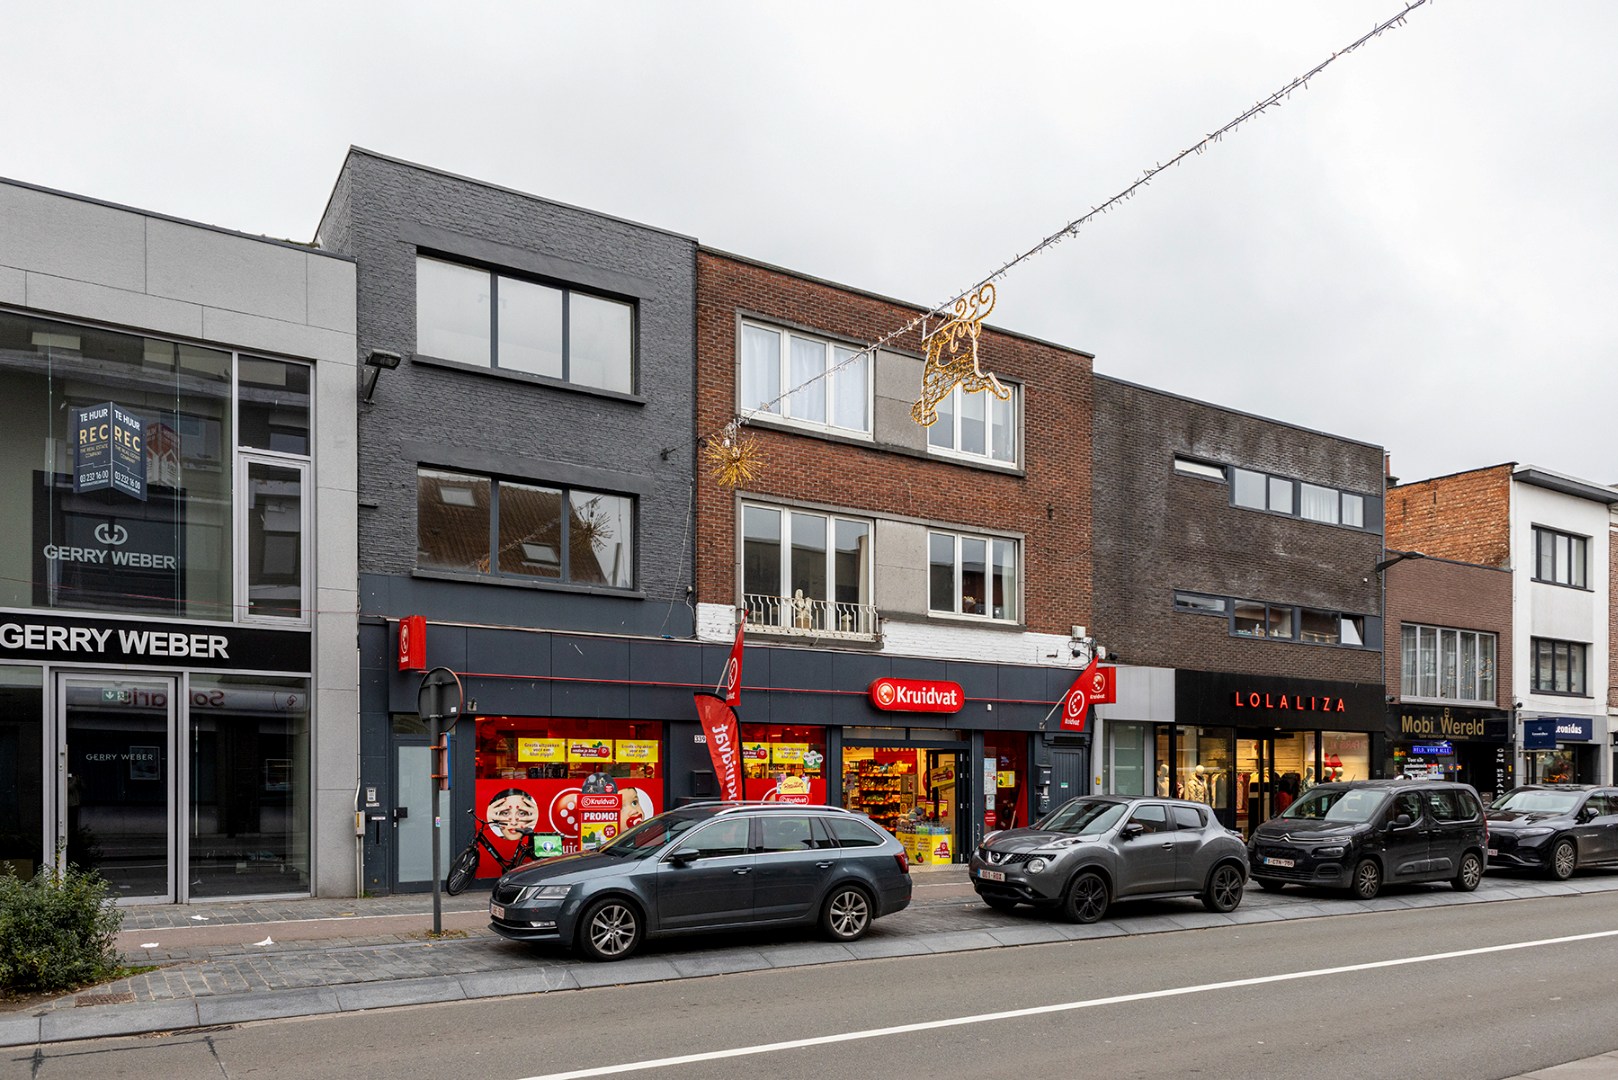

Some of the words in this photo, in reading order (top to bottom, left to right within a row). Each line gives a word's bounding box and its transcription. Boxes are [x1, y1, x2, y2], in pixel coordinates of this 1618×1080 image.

[80, 413, 88, 422] TE
[89, 408, 108, 420] HUUR
[114, 409, 122, 421] TE
[123, 414, 140, 431] HUUR
[80, 424, 108, 445] REC
[114, 425, 141, 452] REC
[80, 474, 86, 483] 03
[86, 472, 95, 481] 232
[95, 471, 102, 480] 16
[102, 469, 109, 478] 00
[43, 544, 108, 564] GERRY
[111, 550, 176, 569] WEBER
[0, 623, 113, 652] GERRY
[118, 629, 230, 659] WEBER
[896, 686, 958, 706] Kruidvat
[1235, 691, 1345, 712] LOLALIZA
[1401, 715, 1434, 734] Mobi
[1440, 716, 1485, 735] Wereld
[1556, 723, 1582, 734] eonidas
[85, 753, 117, 761] GERRY
[120, 753, 154, 761] WEBER
[584, 812, 618, 821] PROMO!
